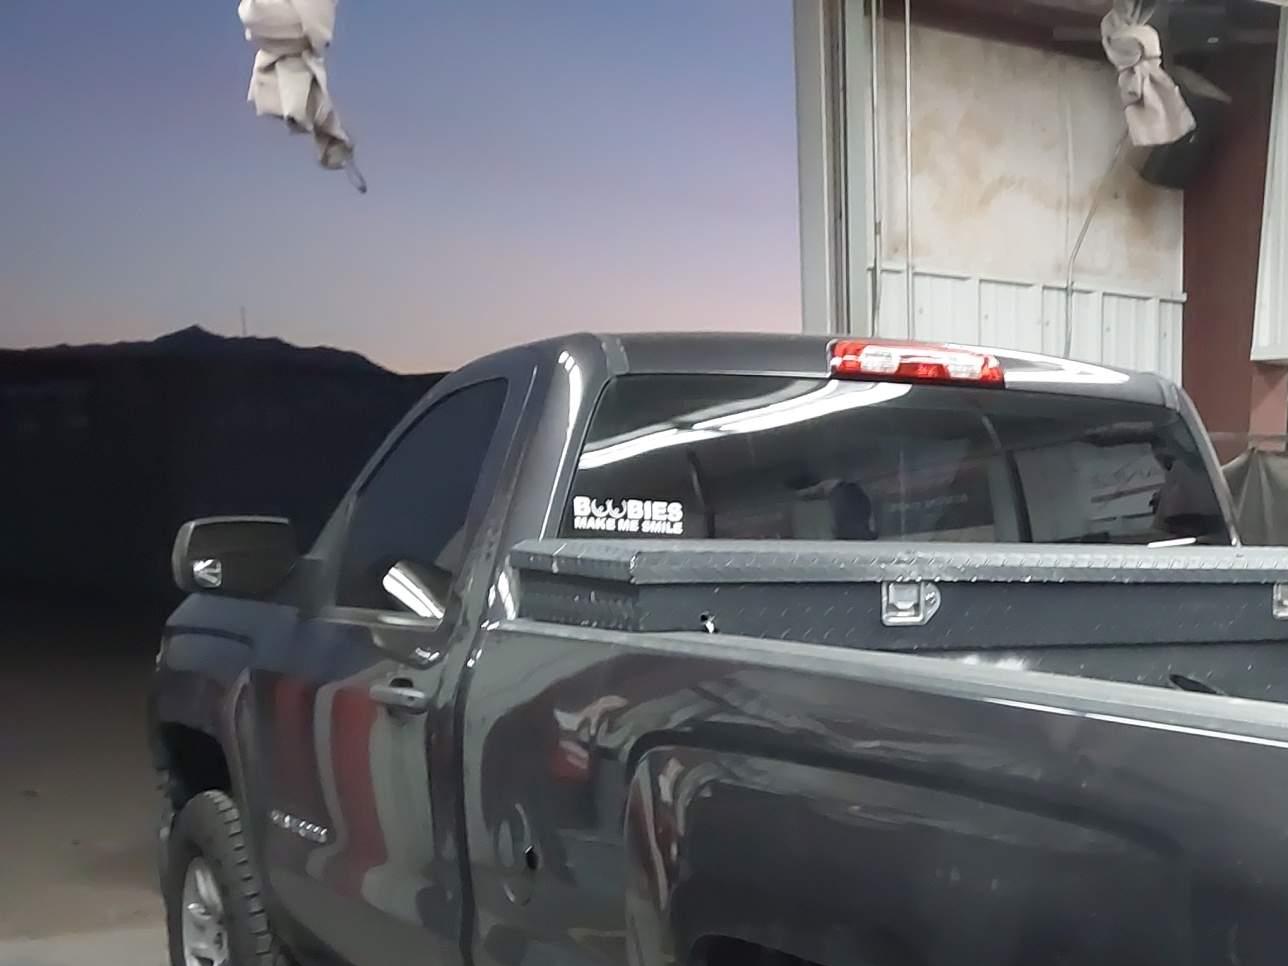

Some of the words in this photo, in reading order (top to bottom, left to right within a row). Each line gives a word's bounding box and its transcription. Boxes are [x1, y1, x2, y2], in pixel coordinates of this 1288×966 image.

[574, 516, 616, 531] MAKE
[618, 518, 640, 532] ME
[641, 519, 684, 535] SMILE
